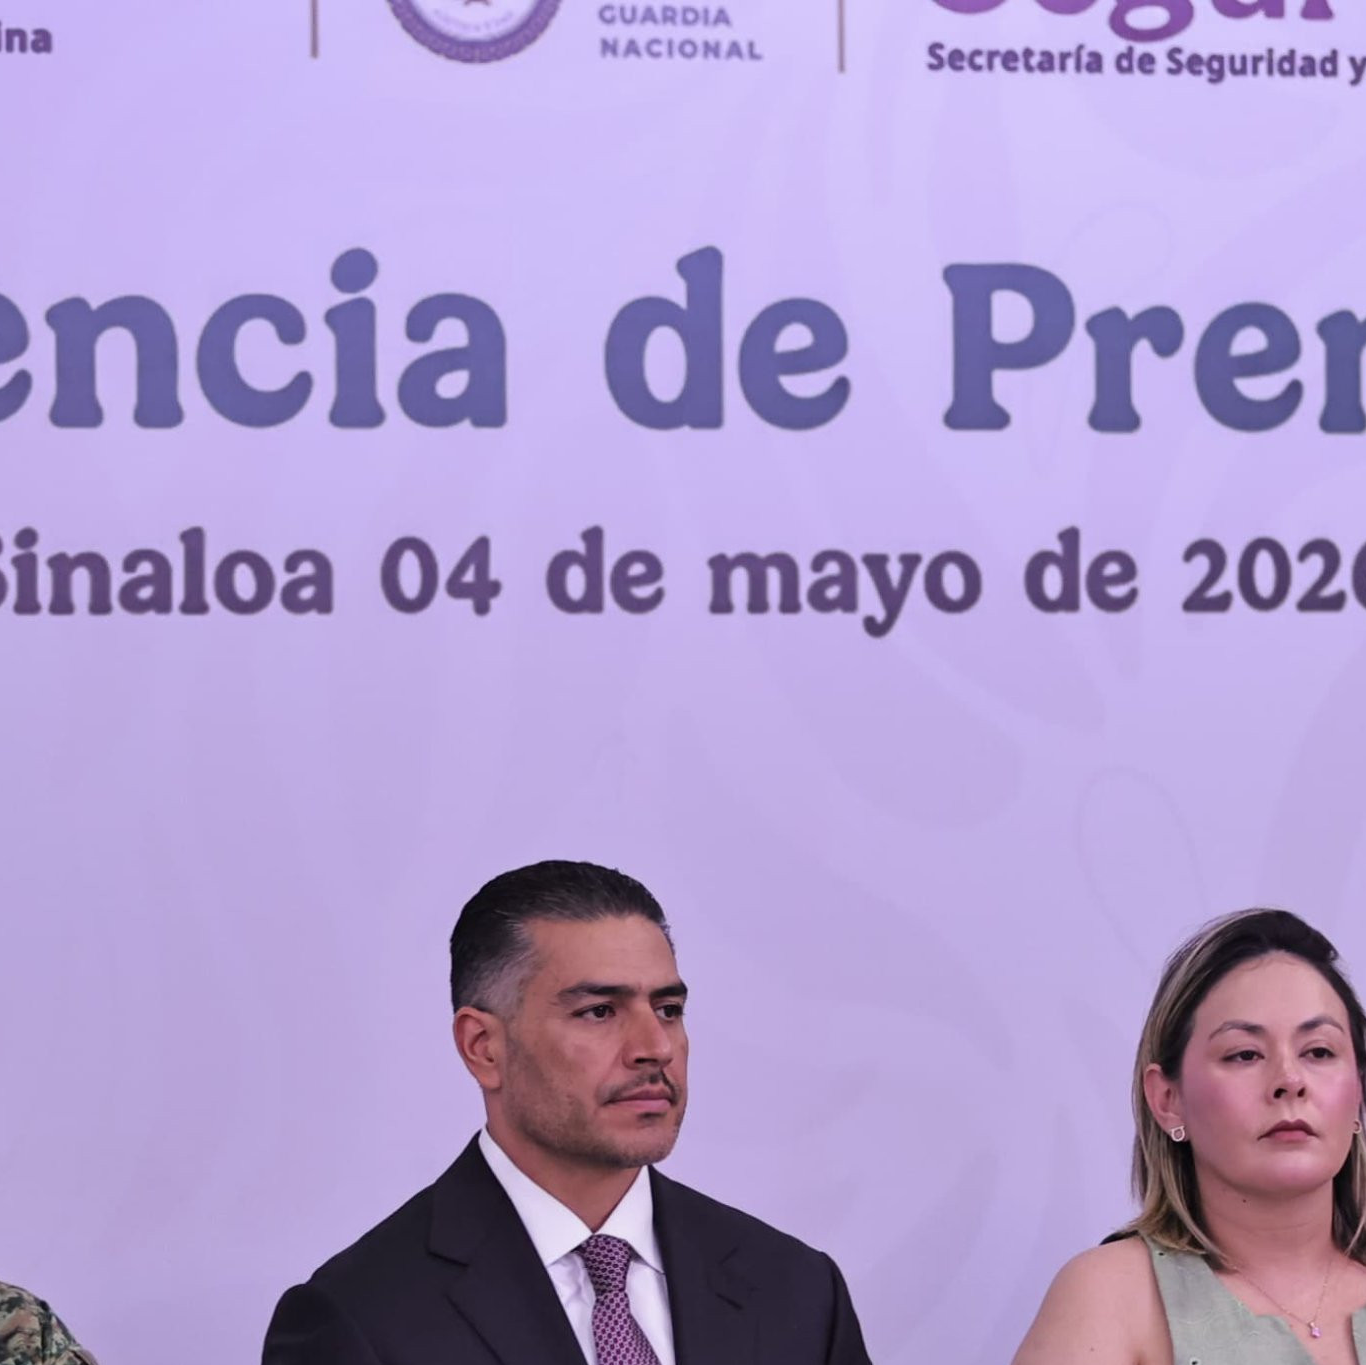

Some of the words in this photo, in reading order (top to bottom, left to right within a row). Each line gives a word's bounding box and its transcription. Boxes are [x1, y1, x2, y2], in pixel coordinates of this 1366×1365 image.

[598, 4, 731, 26] GUARDIA
[600, 38, 762, 61] NACIONAL
[927, 42, 1103, 74] Secretaría
[1115, 46, 1156, 75] de
[1166, 47, 1338, 84] Seguridad
[604, 245, 851, 431] de
[381, 535, 502, 616] 04
[546, 524, 665, 614] de
[707, 548, 982, 638] mayo
[1024, 525, 1139, 613] de
